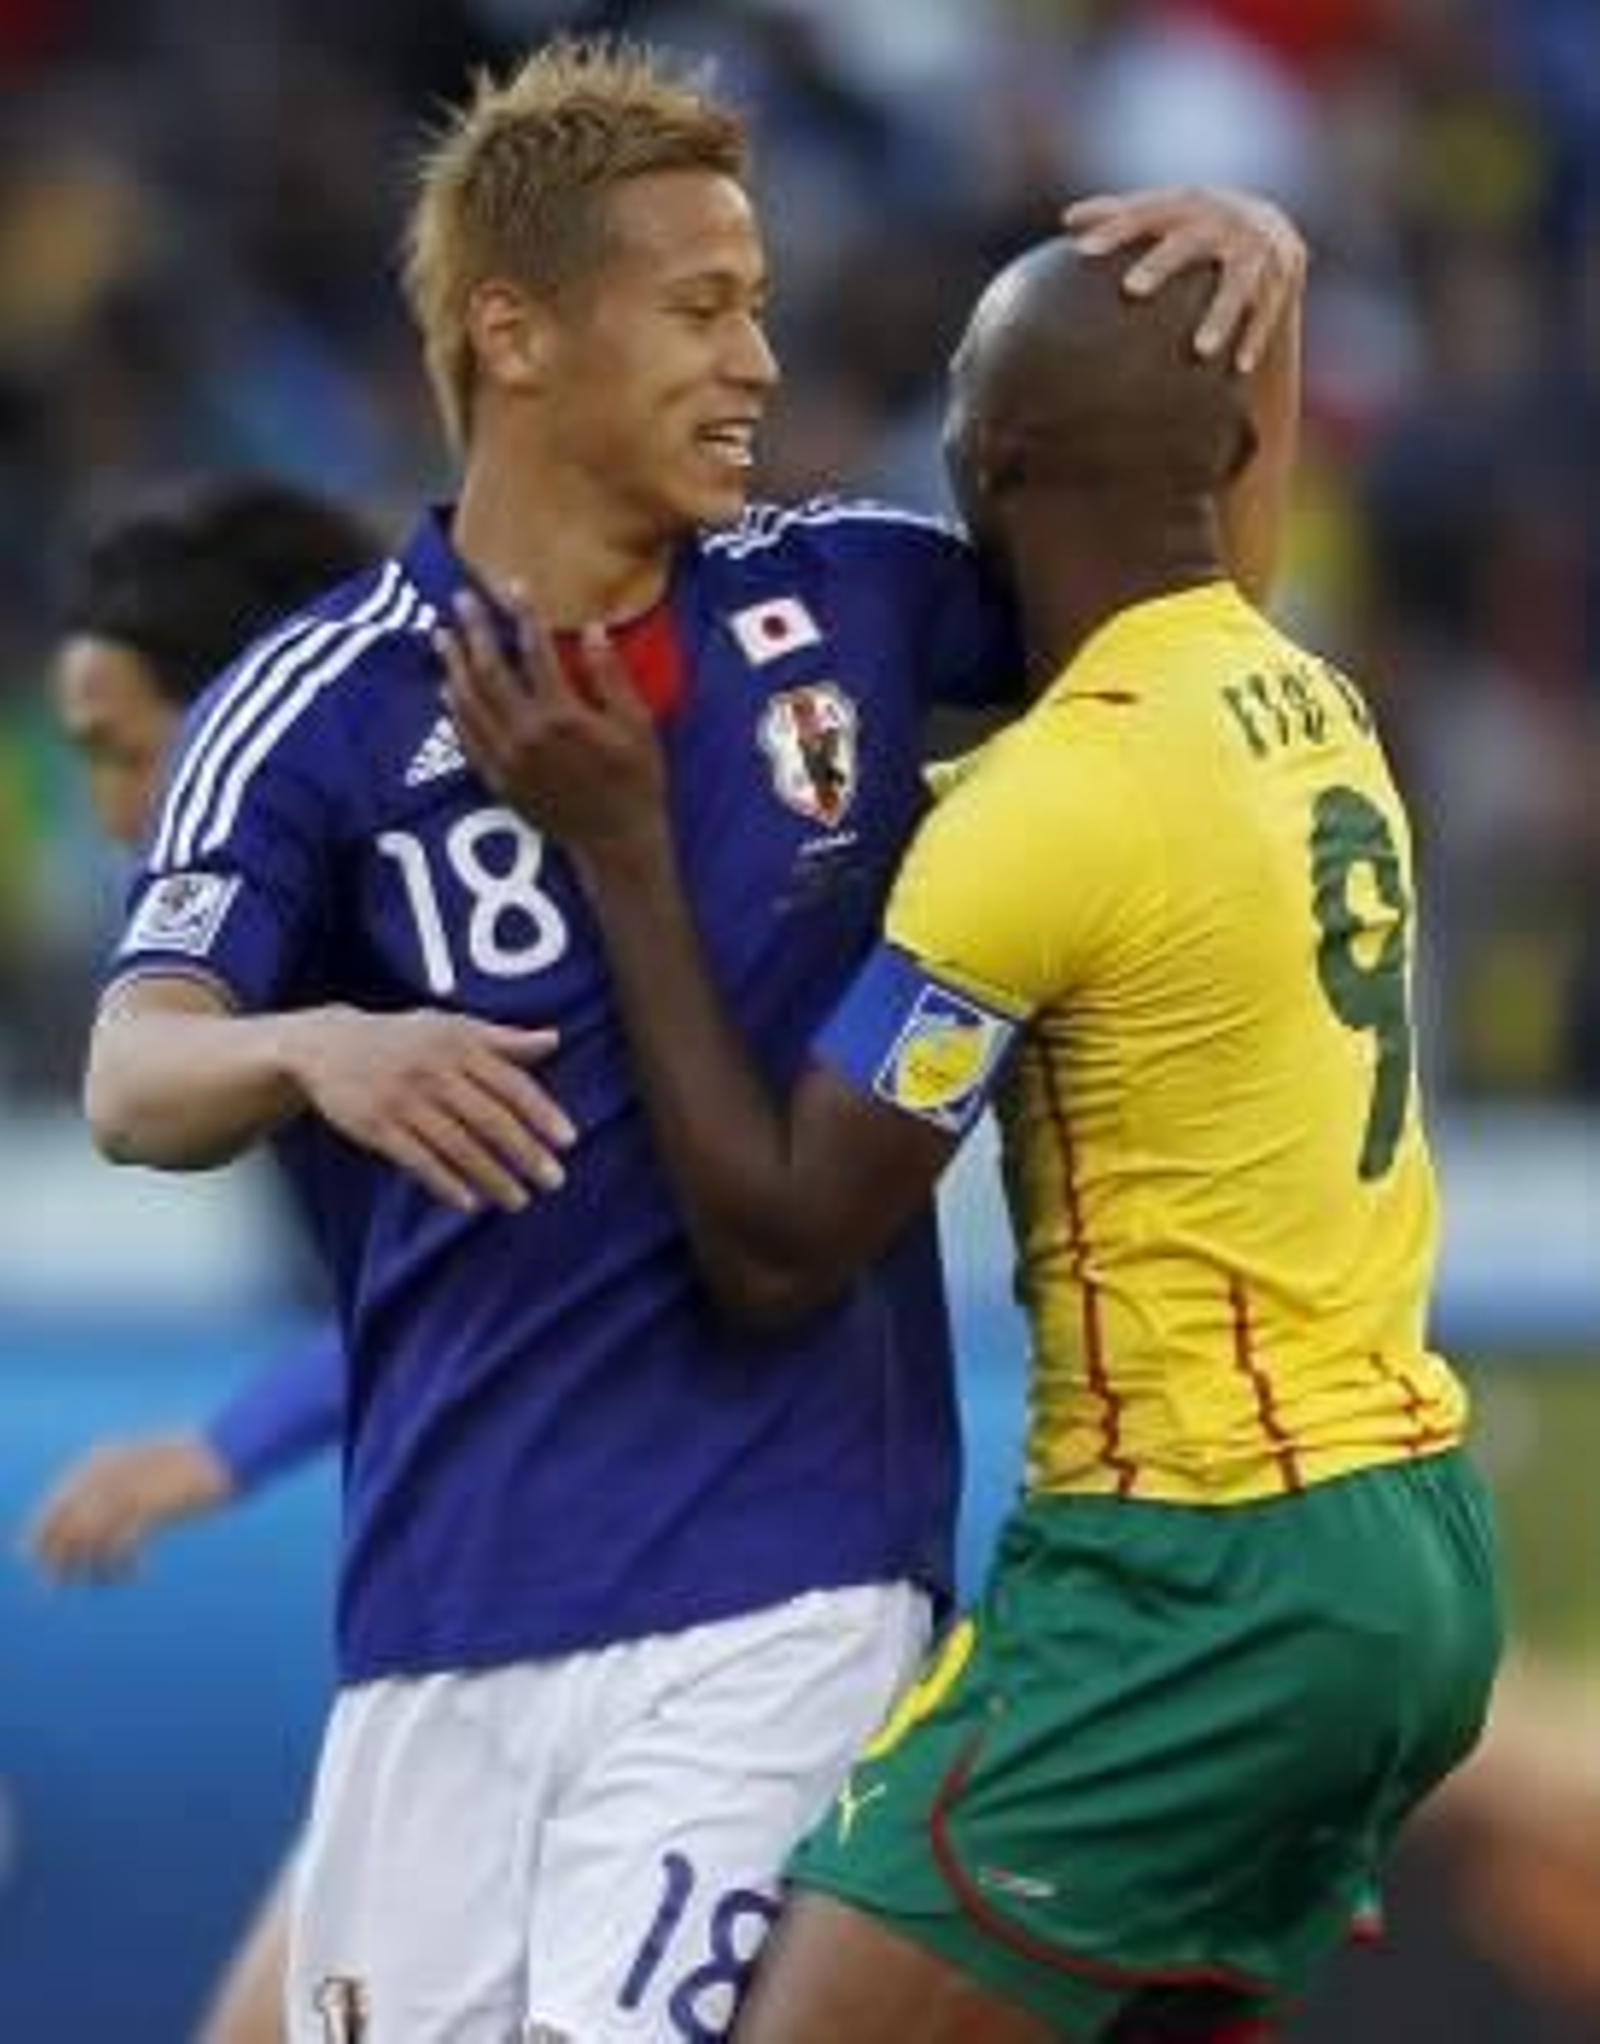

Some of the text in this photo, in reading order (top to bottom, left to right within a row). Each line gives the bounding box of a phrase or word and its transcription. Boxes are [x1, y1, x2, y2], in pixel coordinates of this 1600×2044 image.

[376, 807, 570, 996] 18
[1310, 784, 1410, 1182] 9
[616, 1850, 783, 2044] 18
